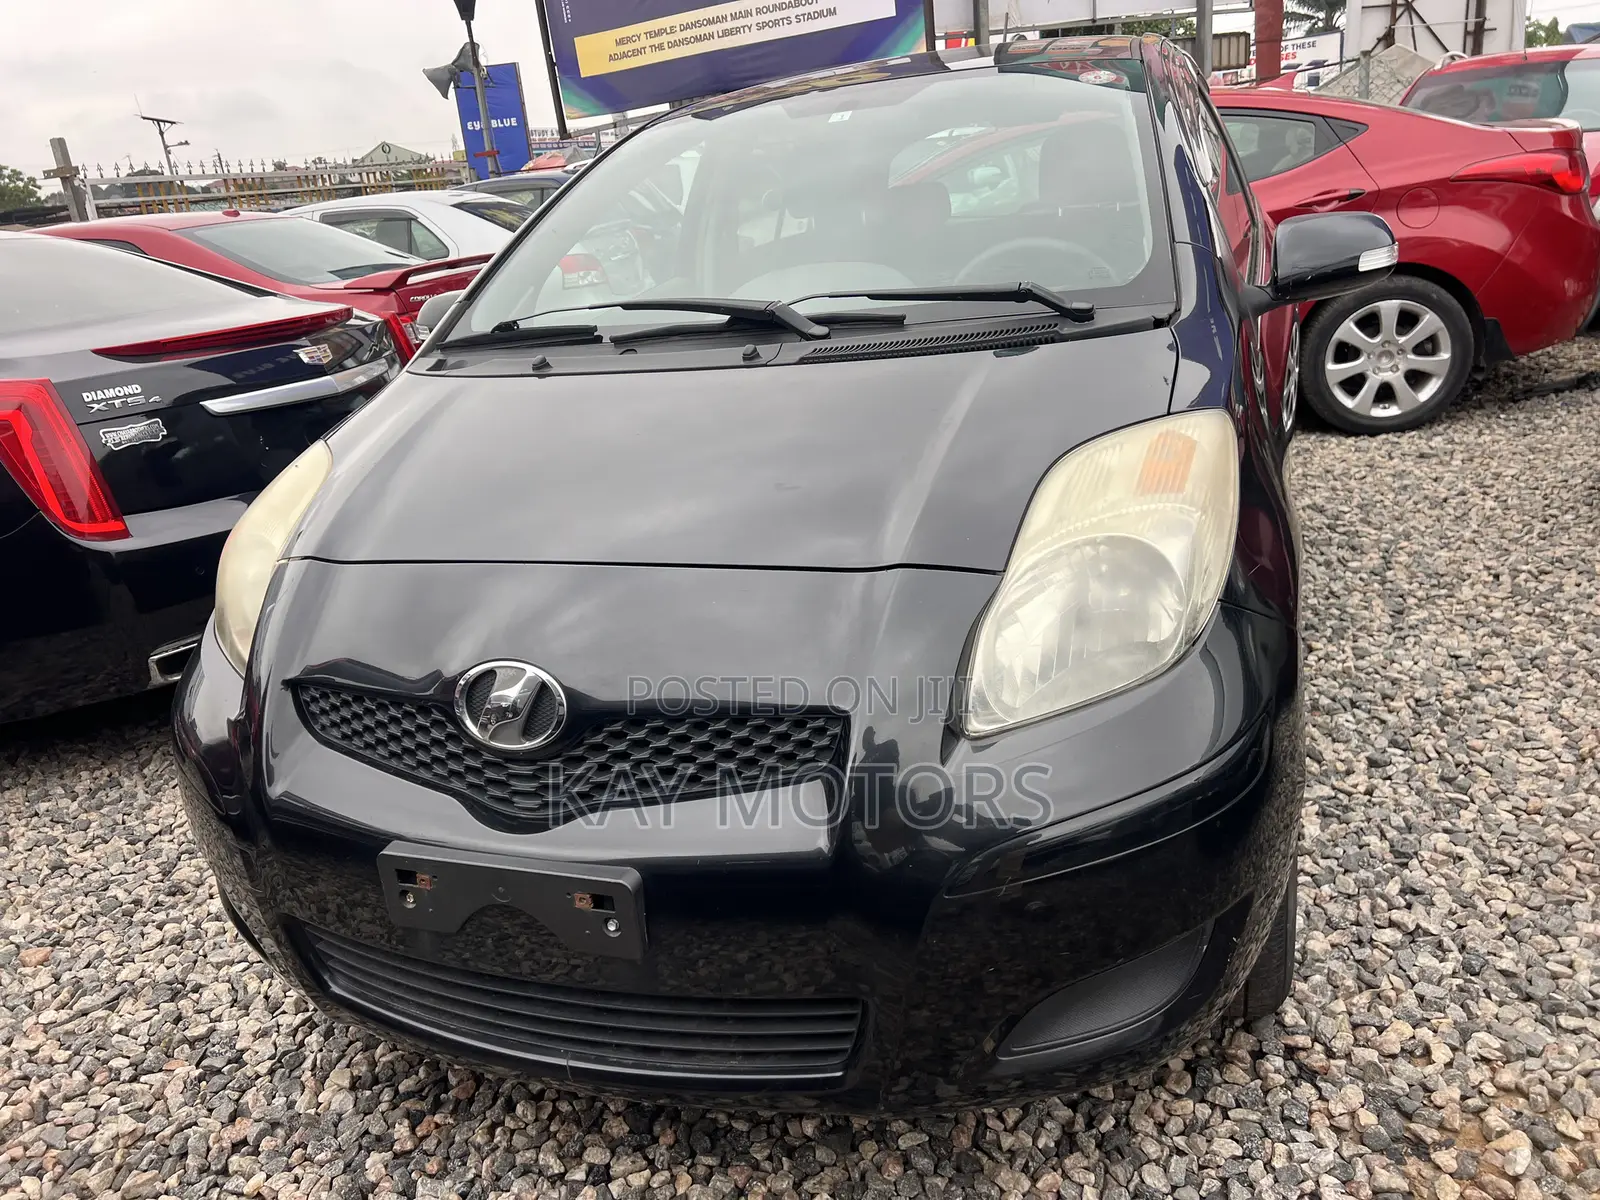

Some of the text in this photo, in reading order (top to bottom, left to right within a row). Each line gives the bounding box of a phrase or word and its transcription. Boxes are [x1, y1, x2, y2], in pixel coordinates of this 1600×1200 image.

[608, 7, 837, 63] ADJACENT THE DANSOMAN LIBERTY SPORTS STADIUM
[615, 33, 641, 47] MERCY
[644, 26, 677, 40] TEMPLE:
[680, 14, 728, 32] DANSOMAN
[730, 8, 753, 21] MAIN
[1291, 41, 1317, 51] THESE
[491, 117, 518, 128] BLUE
[81, 384, 142, 403] DIAMOND
[86, 395, 146, 414] XTS
